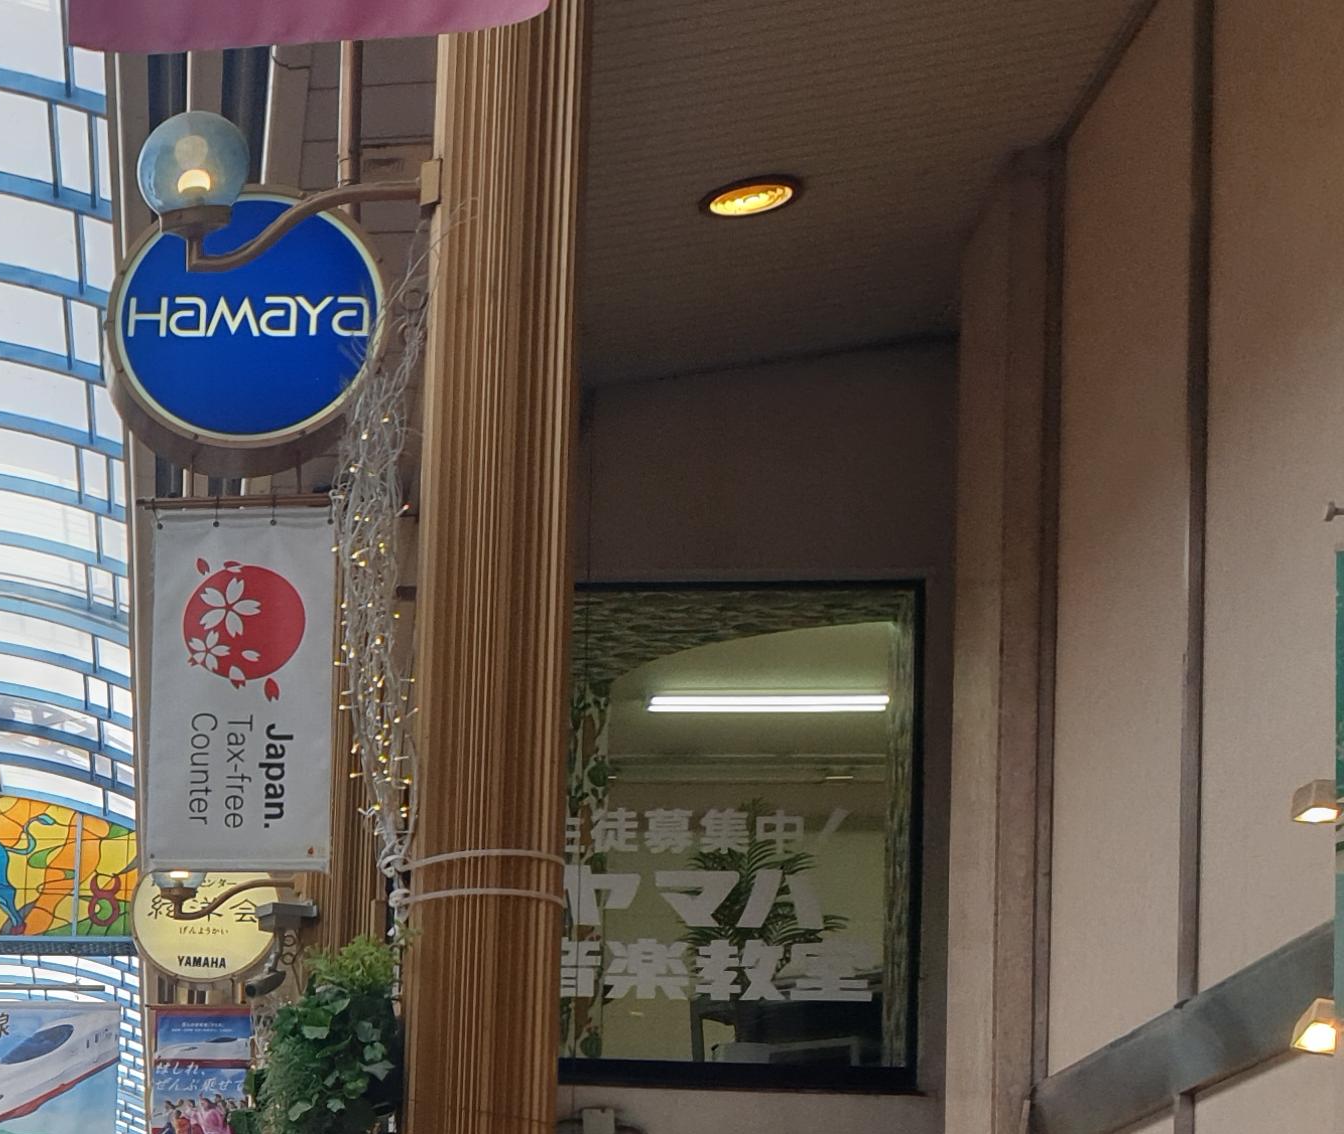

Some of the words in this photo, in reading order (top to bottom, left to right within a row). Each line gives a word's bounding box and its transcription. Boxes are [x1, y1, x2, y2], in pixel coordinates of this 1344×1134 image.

[188, 710, 218, 827] Counter
[223, 713, 255, 830] Tax-free
[258, 722, 294, 831] Japan.
[564, 865, 825, 930] ヤマハ
[177, 955, 227, 968] YAMAHA
